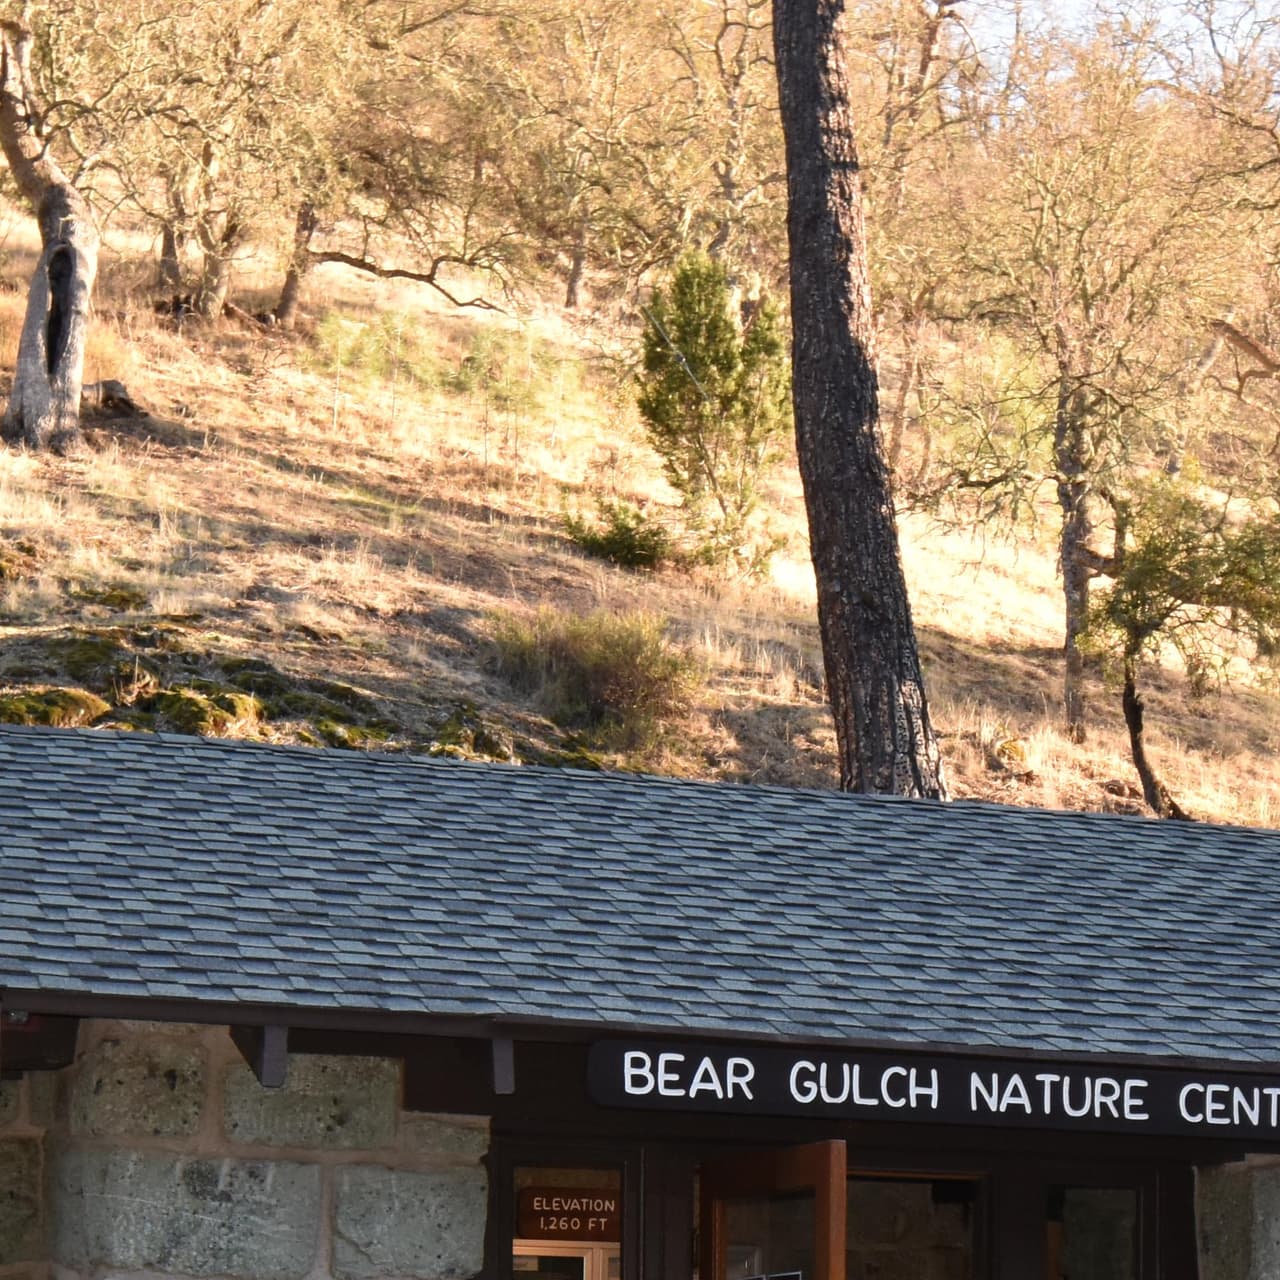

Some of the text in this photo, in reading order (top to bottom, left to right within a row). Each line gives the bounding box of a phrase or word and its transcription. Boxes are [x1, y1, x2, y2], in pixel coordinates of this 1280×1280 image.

[624, 1050, 755, 1100] BEAR
[789, 1060, 939, 1109] GULCH
[970, 1071, 1150, 1120] NATURE
[533, 1197, 615, 1212] ELEVATION
[540, 1216, 608, 1231] 1,260 FT
